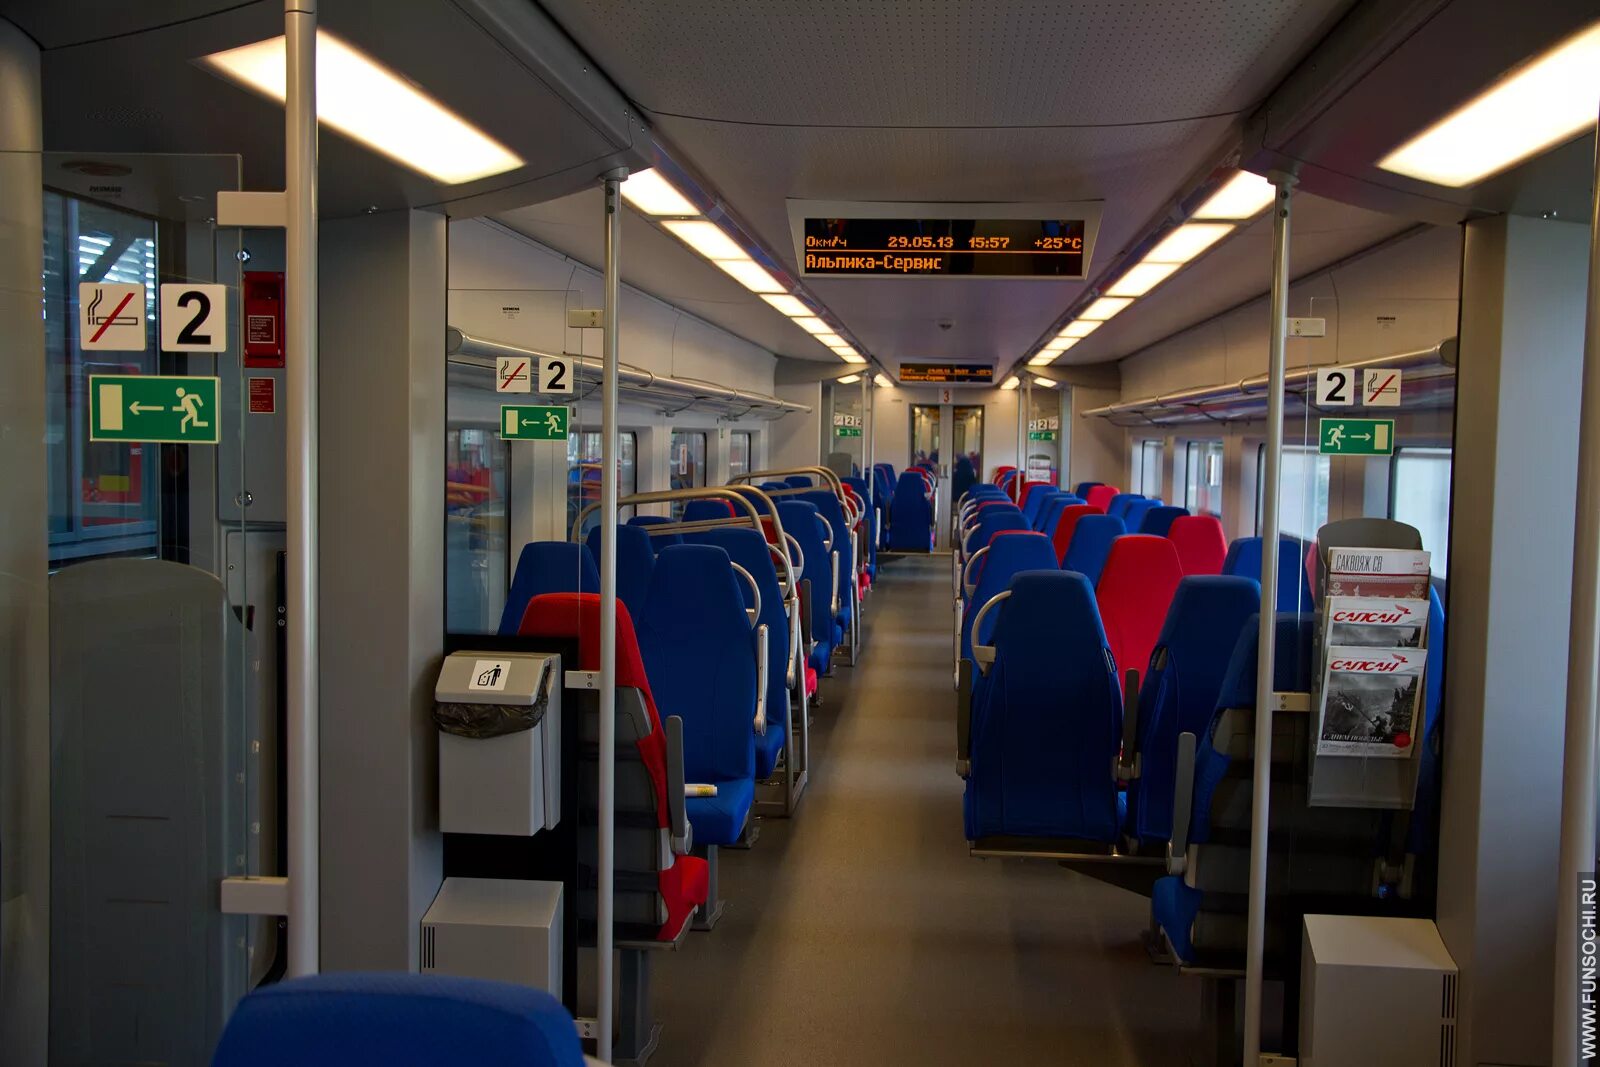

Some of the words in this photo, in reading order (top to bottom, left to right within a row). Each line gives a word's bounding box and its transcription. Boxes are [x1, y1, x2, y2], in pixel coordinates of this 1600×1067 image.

[888, 236, 954, 248] 29.05.13
[968, 237, 1010, 249] 15:57
[805, 254, 942, 272] Альпика-Сервис
[176, 290, 212, 346] 2
[546, 361, 566, 390] 2
[1325, 372, 1346, 402] 2
[847, 416, 852, 425] 2
[1040, 420, 1045, 428] 2
[1335, 553, 1371, 571] САКВОЯЖ
[1372, 555, 1383, 573] СВ
[1333, 610, 1403, 624] САПСАН
[1330, 659, 1400, 672] САПСАН
